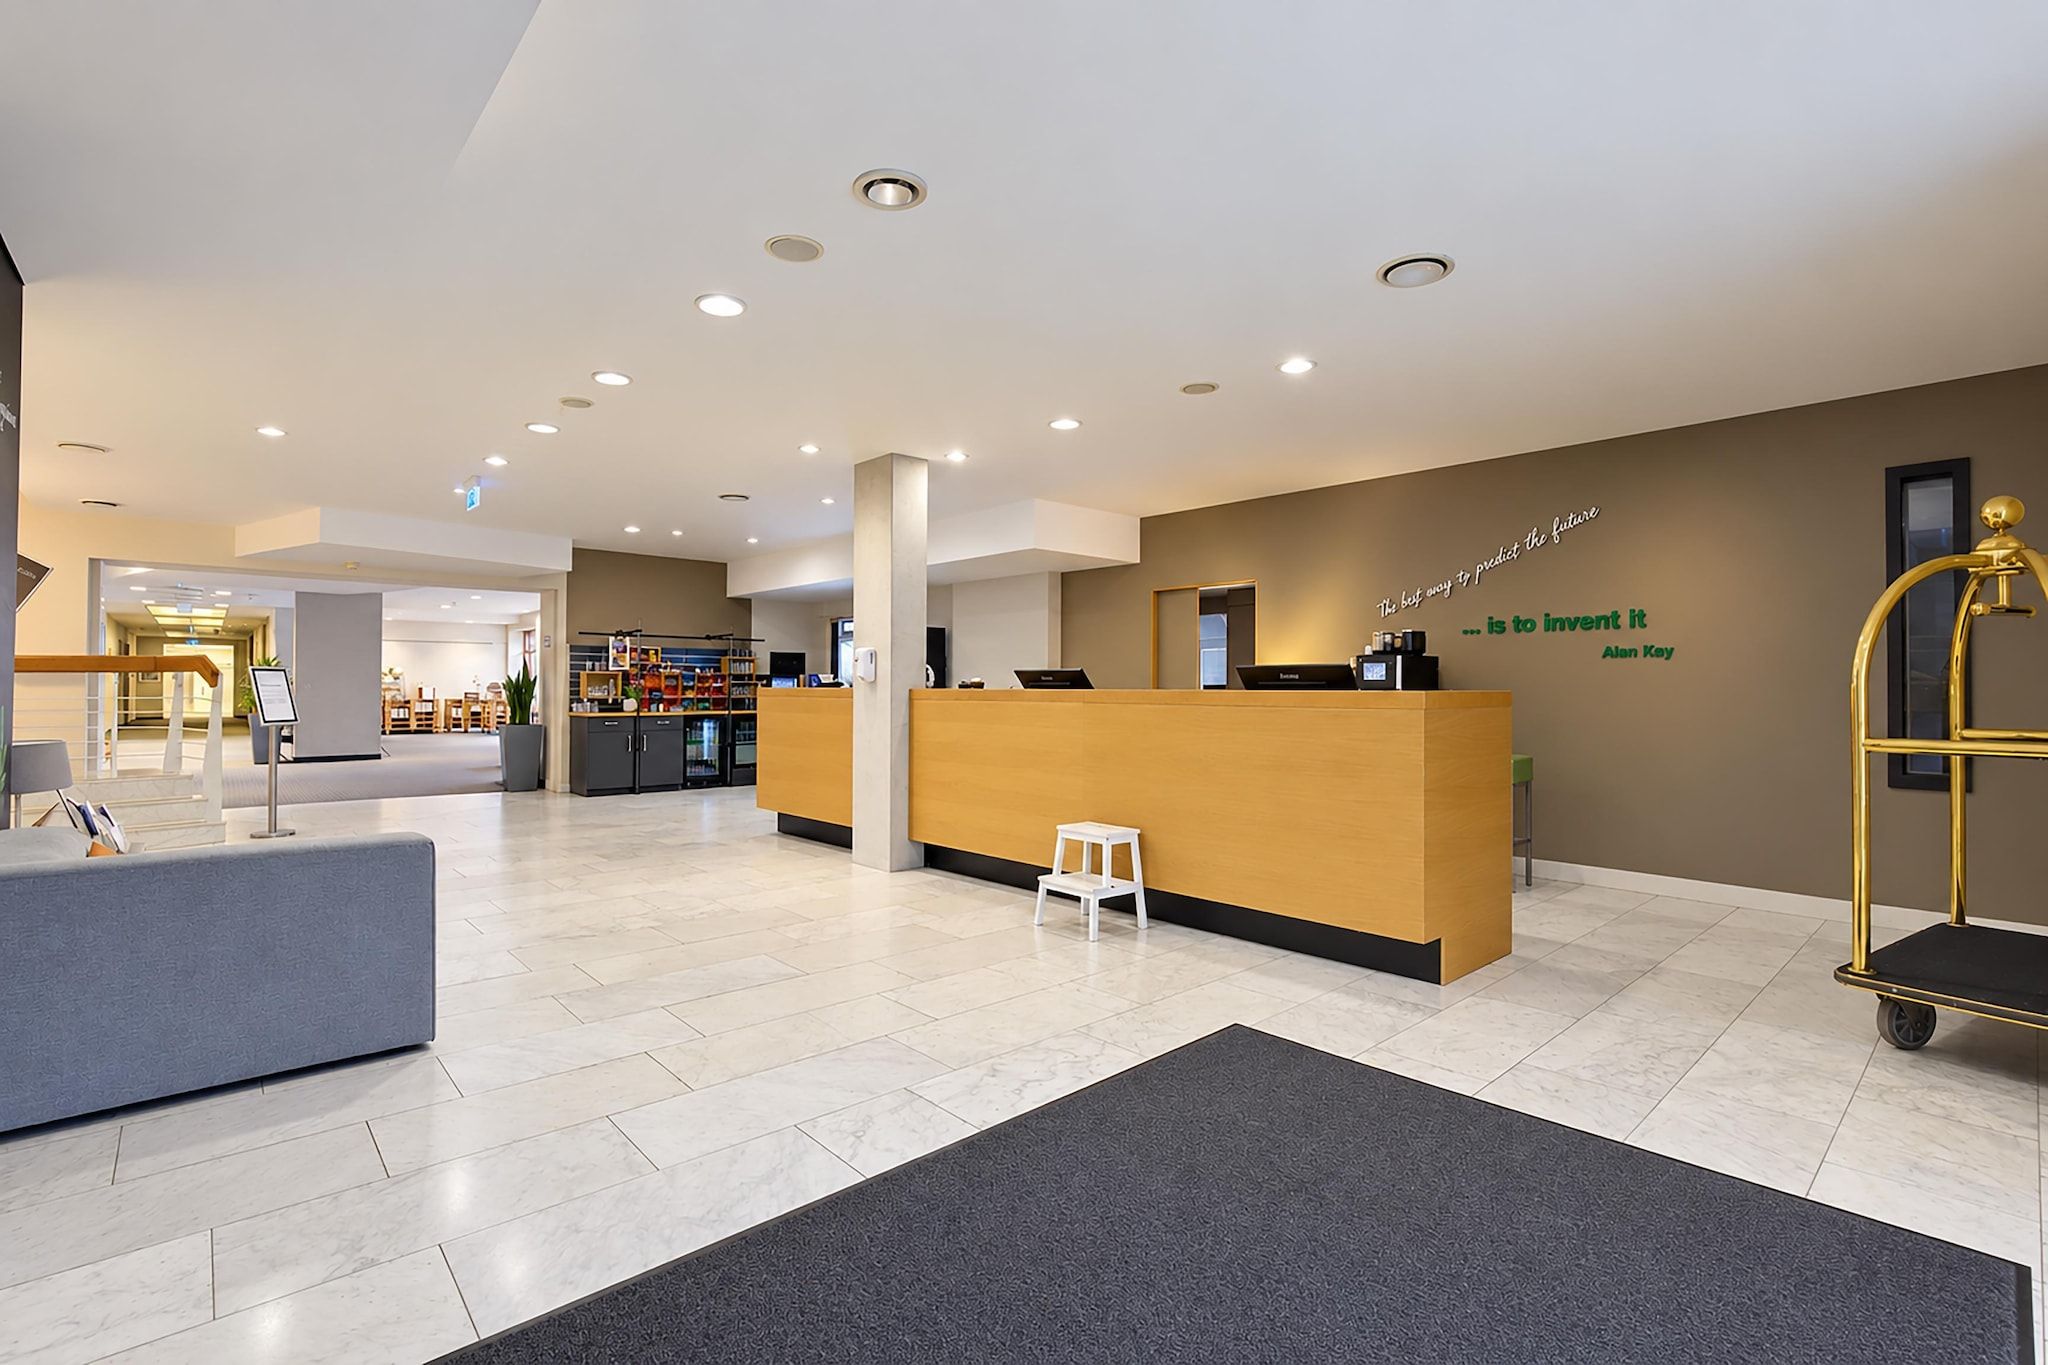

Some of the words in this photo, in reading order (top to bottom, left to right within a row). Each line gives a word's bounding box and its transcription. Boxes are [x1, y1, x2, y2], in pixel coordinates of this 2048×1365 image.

[1401, 587, 1423, 608] best
[1426, 580, 1453, 598] way
[1475, 542, 1520, 585] predict
[1524, 526, 1548, 550] the
[1551, 506, 1600, 544] future
[1487, 616, 1507, 635] is
[1512, 615, 1537, 634] to
[1544, 610, 1621, 633] invent
[1629, 608, 1648, 630] it
[1602, 645, 1638, 659] Alan
[1643, 645, 1675, 661] Kay
